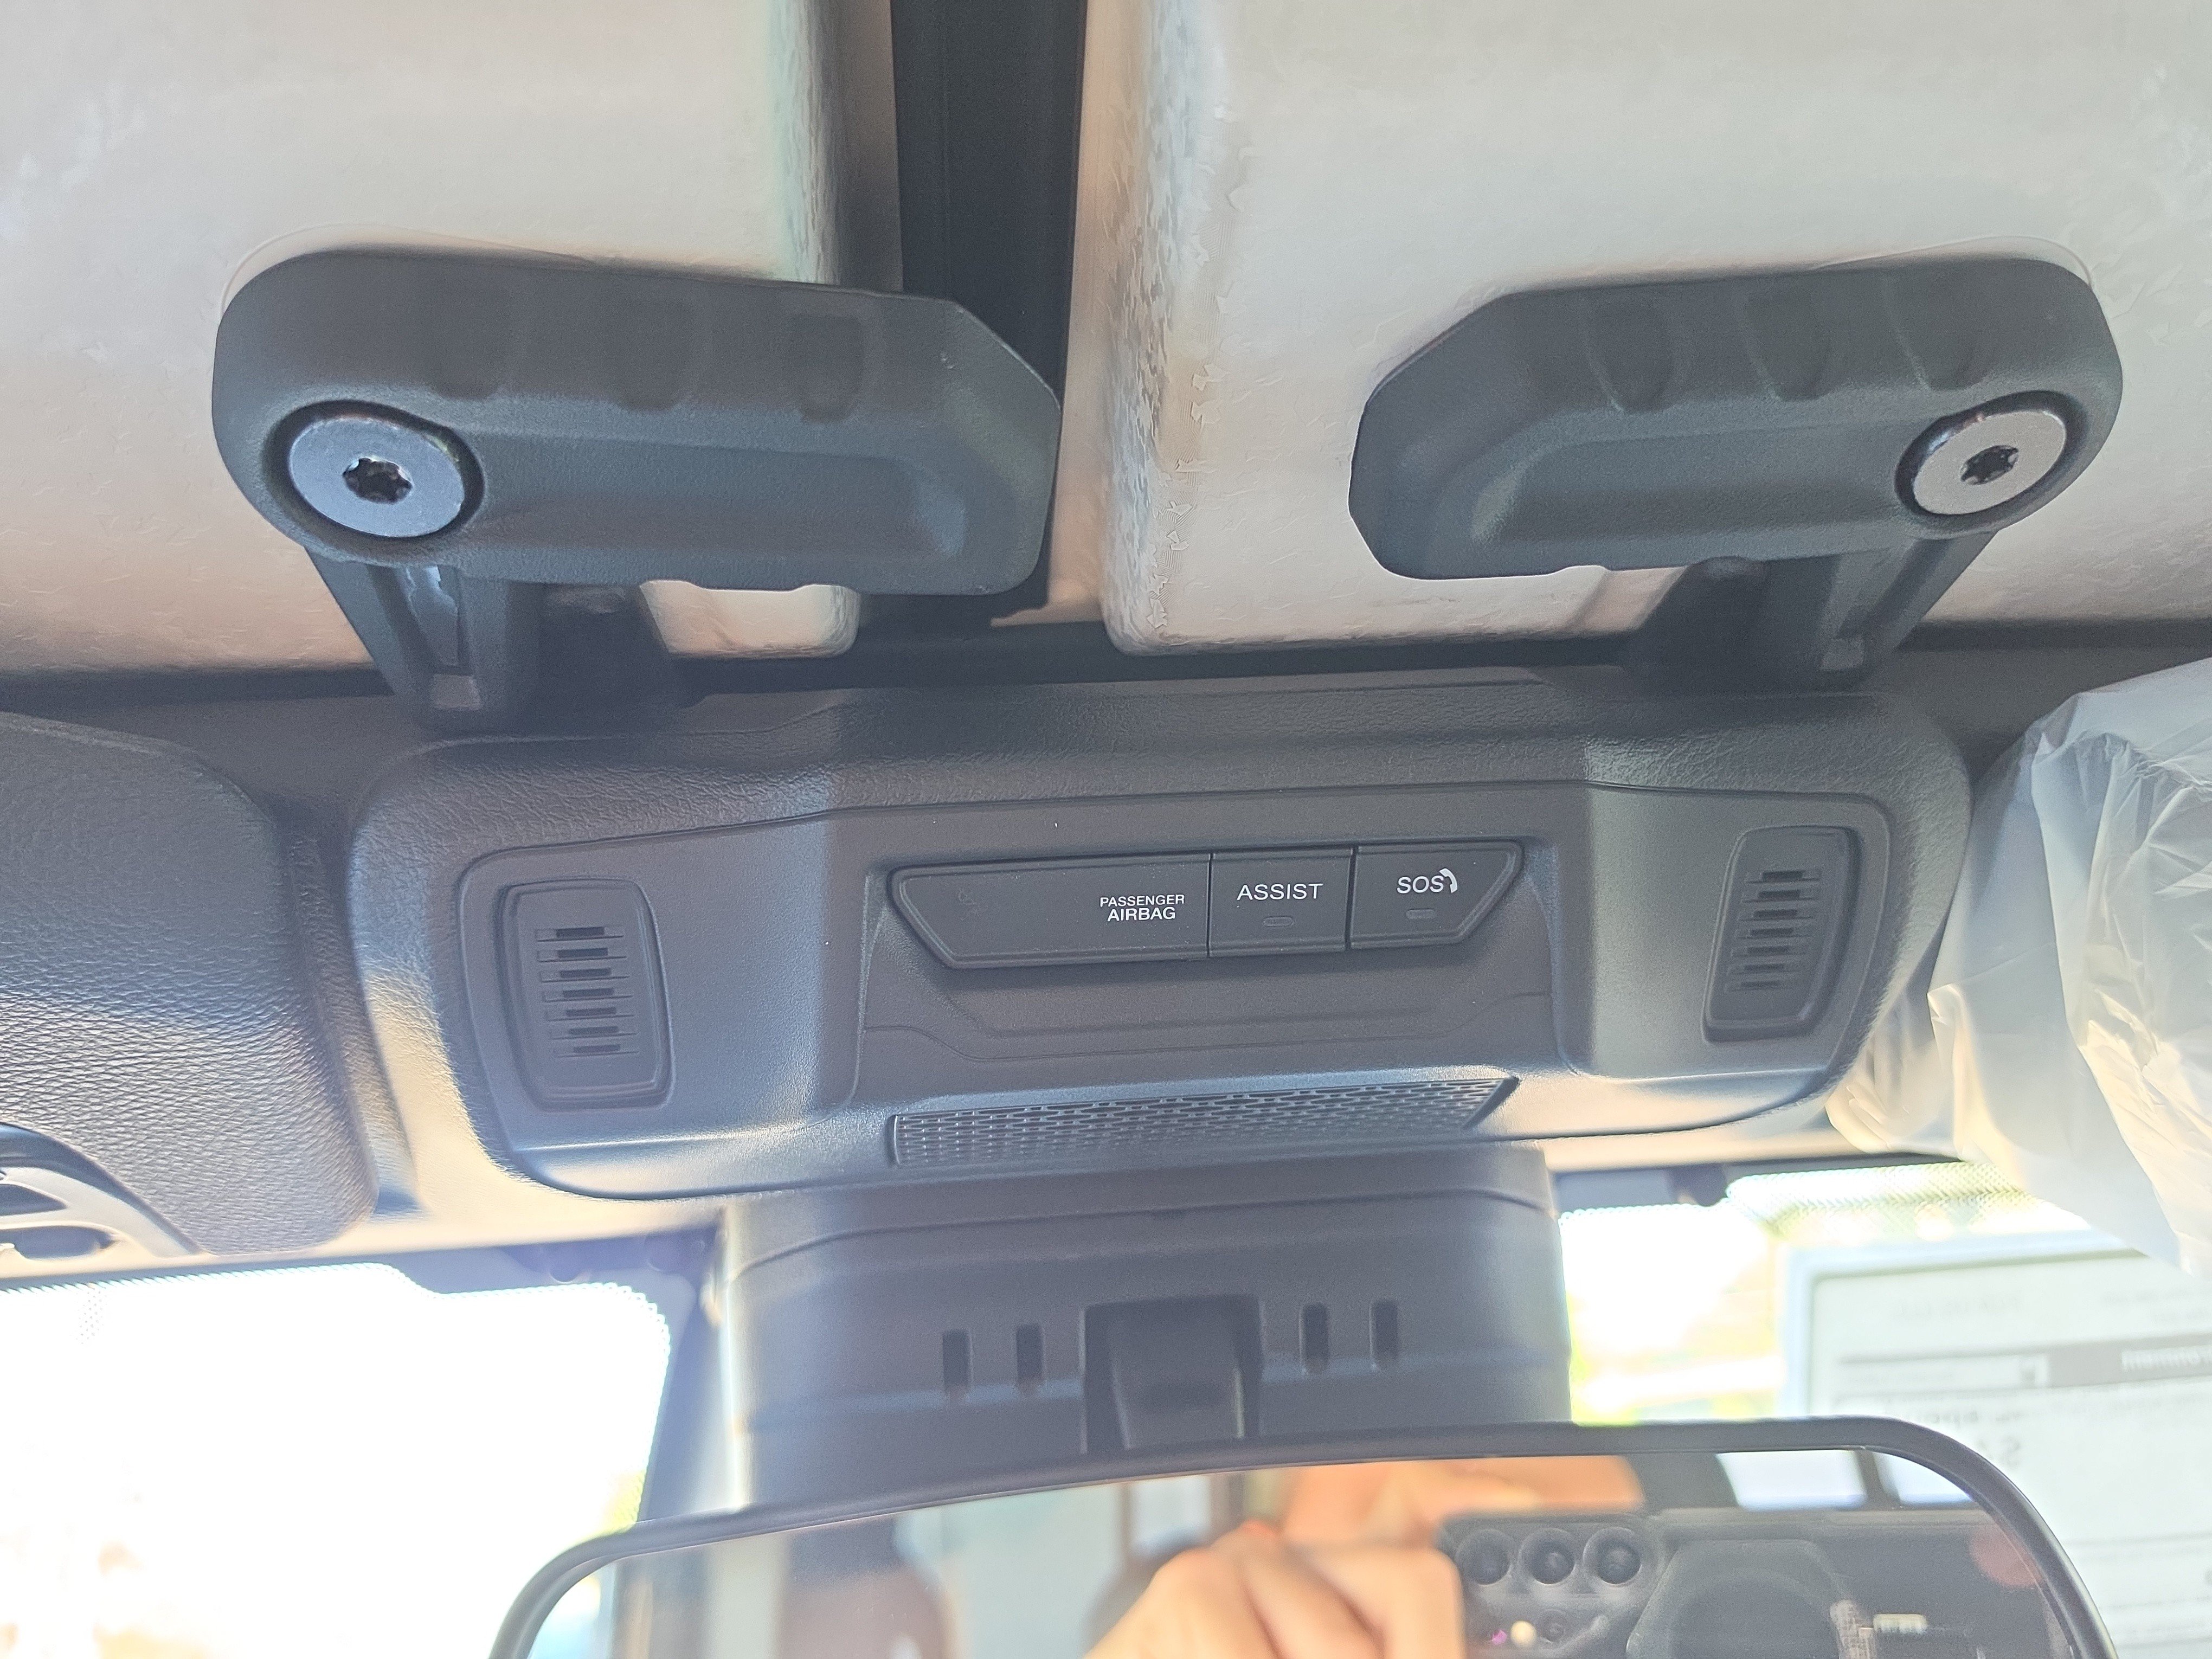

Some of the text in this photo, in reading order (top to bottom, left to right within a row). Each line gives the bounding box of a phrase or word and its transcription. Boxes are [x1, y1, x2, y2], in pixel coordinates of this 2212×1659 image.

[1237, 883, 1323, 901] ASSIST
[1397, 875, 1444, 894] SOS
[1099, 894, 1185, 908] PASSENGER
[1107, 906, 1176, 922] AIRBAG
